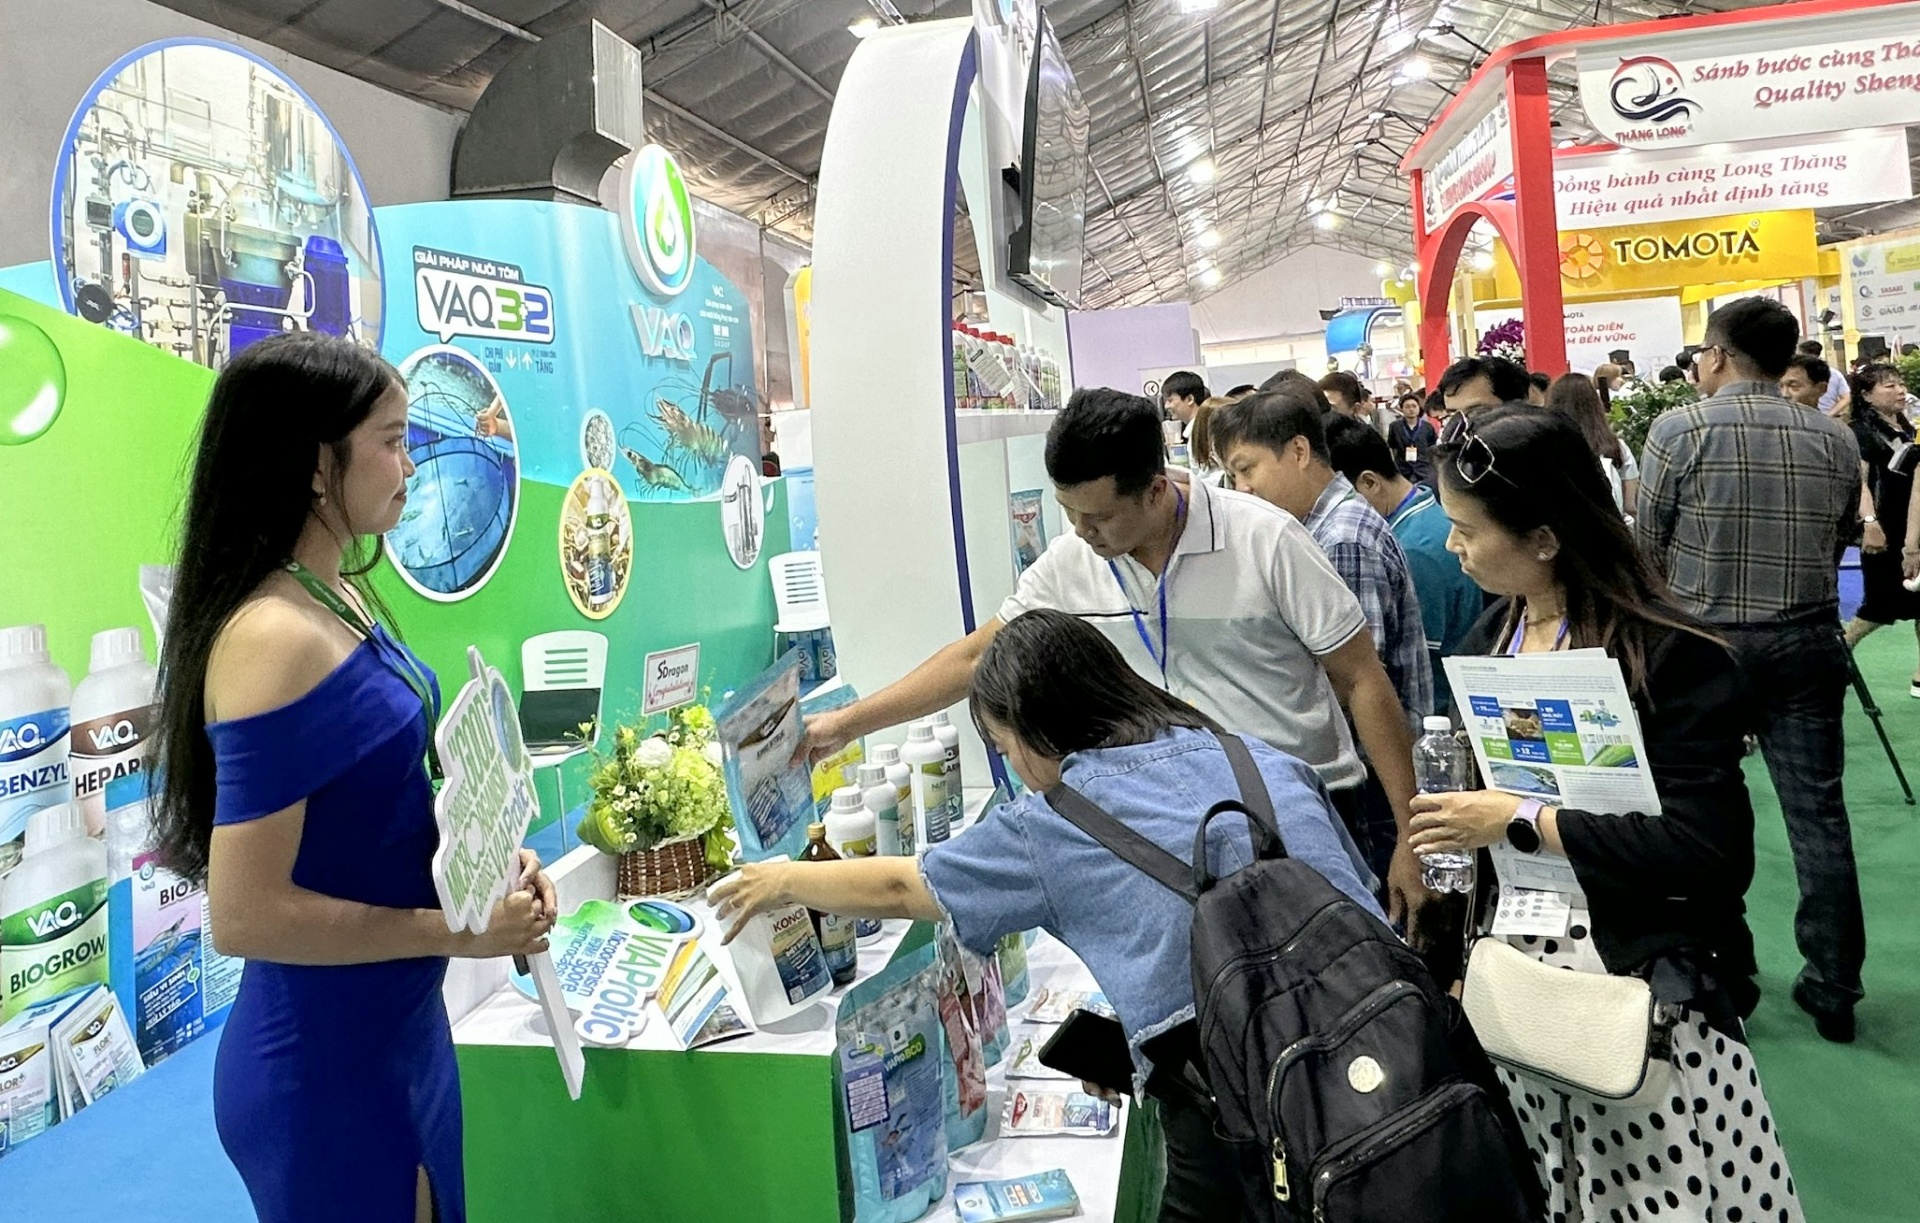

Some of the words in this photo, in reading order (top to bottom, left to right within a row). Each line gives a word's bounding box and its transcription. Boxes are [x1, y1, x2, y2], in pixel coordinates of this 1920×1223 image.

[1692, 60, 1749, 83] Sánh
[1756, 53, 1811, 76] bước
[1818, 49, 1874, 68] cùng
[1754, 79, 1846, 109] Quality
[1615, 128, 1653, 143] THĂNG
[1657, 125, 1686, 139] LONG
[1607, 166, 1659, 189] hành
[1666, 165, 1716, 184] cùng
[1722, 160, 1773, 180] Long
[1780, 154, 1848, 172] Thăng
[1569, 196, 1618, 217] Hiệu
[1624, 192, 1663, 214] quả
[1671, 184, 1718, 206] nhất
[1725, 182, 1774, 202] định
[1780, 180, 1830, 198] tăng
[1613, 229, 1760, 263] TOMOTA
[439, 256, 469, 271] PHÁP
[471, 262, 497, 277] NUÔI
[497, 265, 519, 281] TÔM
[628, 300, 698, 361] VAQ
[1565, 323, 1594, 334] TOÀN
[1597, 321, 1624, 332] DIỆN
[75, 758, 142, 798] HEPAR
[10, 934, 106, 994] BIOGROW
[561, 958, 591, 992] spore
[577, 929, 630, 997] Microorganism
[583, 935, 674, 1039] VIAProtic
[0, 1073, 25, 1092] LOR+
